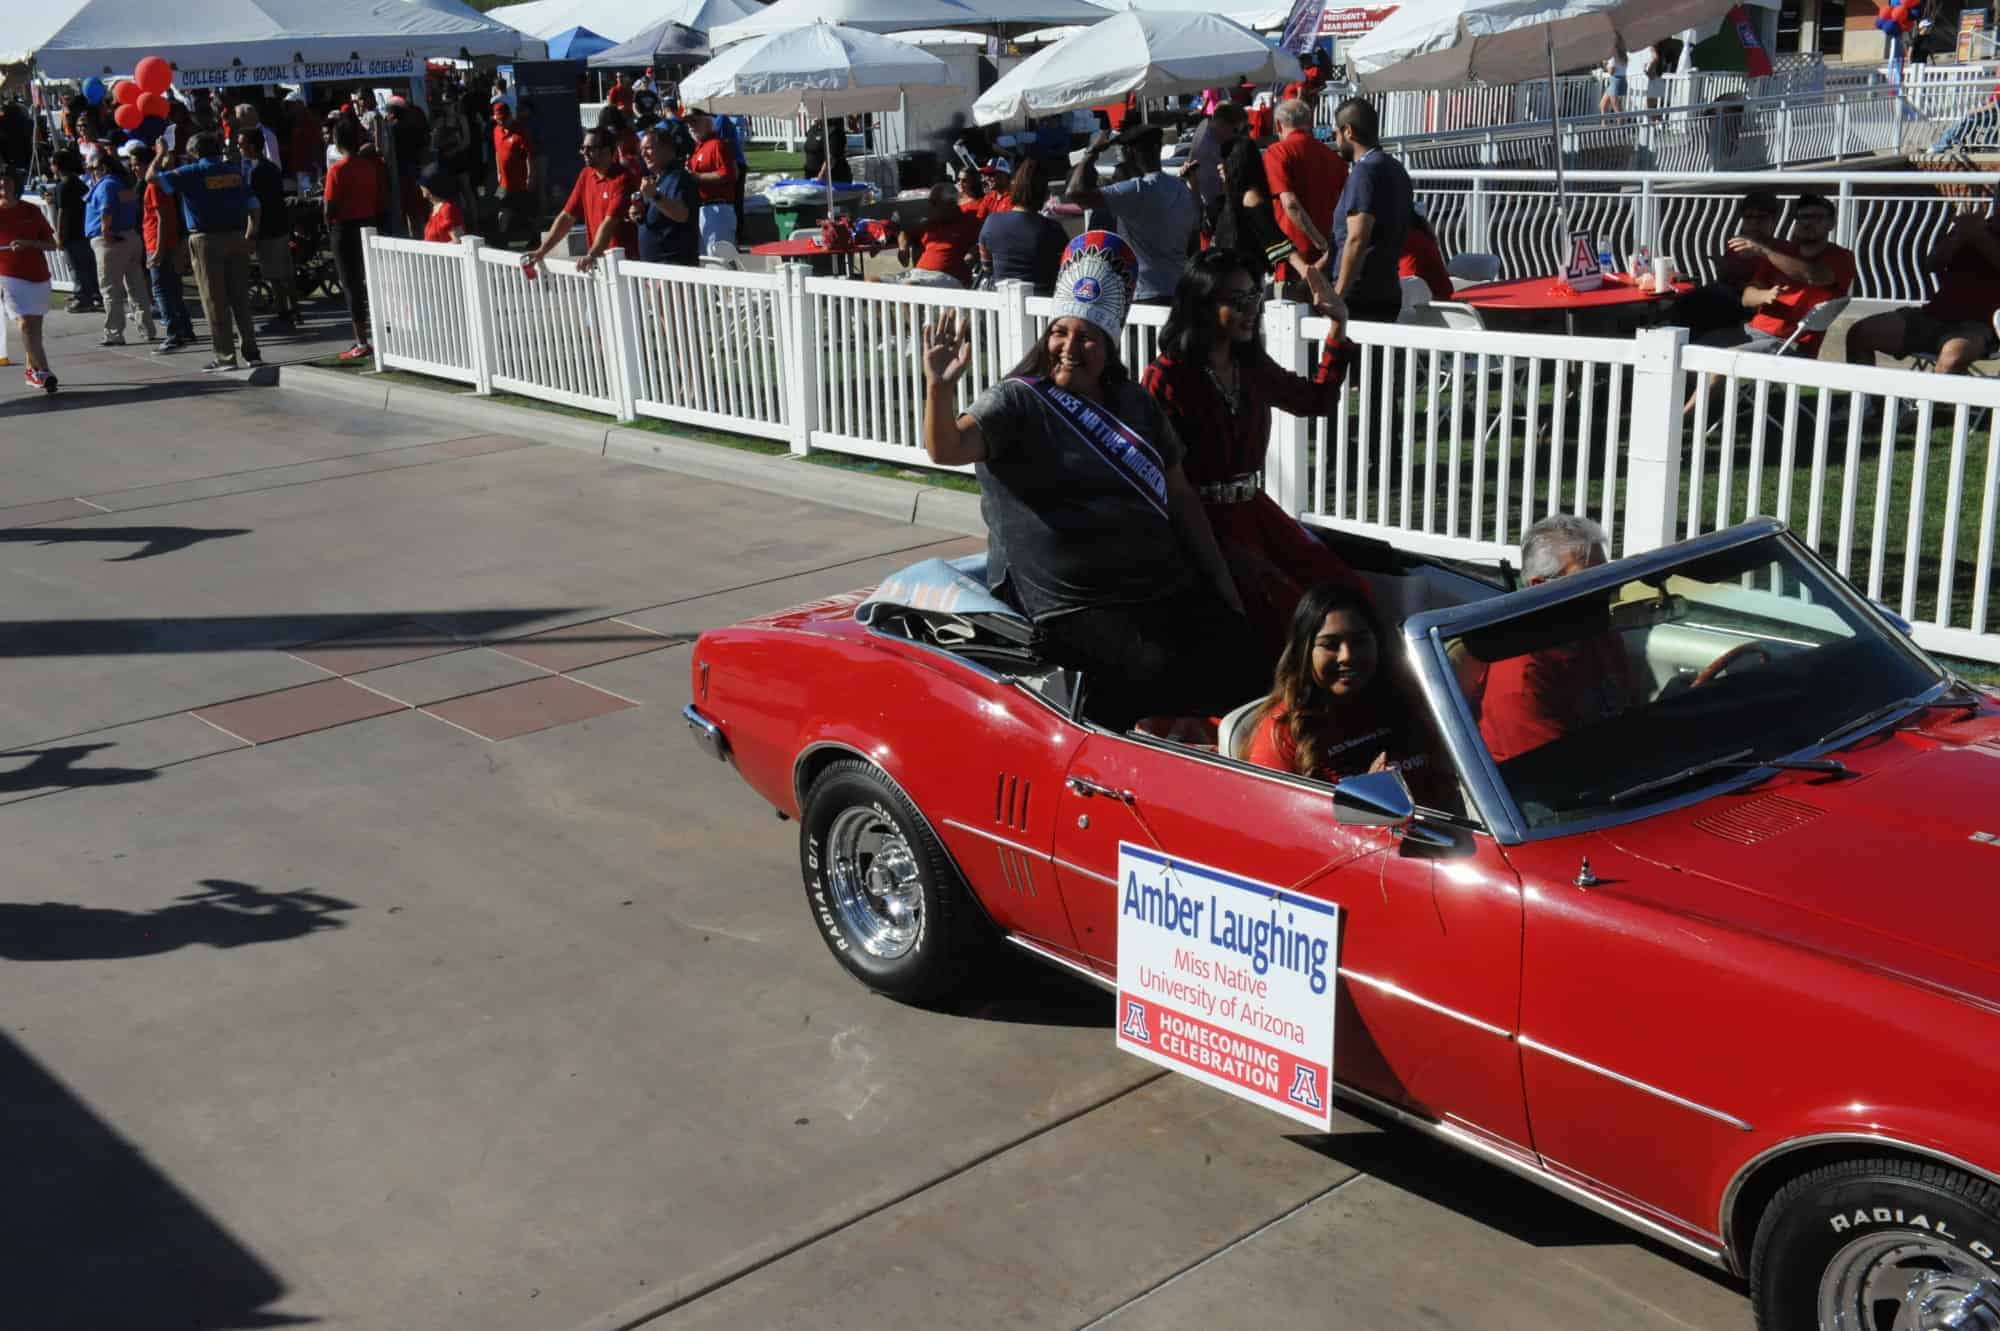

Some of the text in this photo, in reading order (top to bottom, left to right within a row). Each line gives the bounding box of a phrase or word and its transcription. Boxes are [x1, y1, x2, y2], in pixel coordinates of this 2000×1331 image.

[182, 69, 228, 86] COLLEGE
[234, 67, 248, 82] OF
[253, 65, 289, 81] SOCIAL
[305, 60, 365, 79] BEHAVIORAL
[369, 59, 414, 75] SCIENCES
[1566, 230, 1600, 279] A
[1047, 387, 1084, 413] MISS
[1077, 407, 1128, 455] NATIVE
[811, 876, 849, 951] RADIAL
[1123, 870, 1329, 995] Amber Laughing
[1174, 947, 1268, 1000] Miss Native
[1123, 1000, 1150, 1042] A
[1139, 965, 1305, 1045] University of Arizona
[1159, 1012, 1280, 1070] HOMECOMING
[1159, 1032, 1280, 1093] CELEBRATION
[1289, 1064, 1322, 1109] A
[1829, 1207, 1957, 1240] RADIAL
